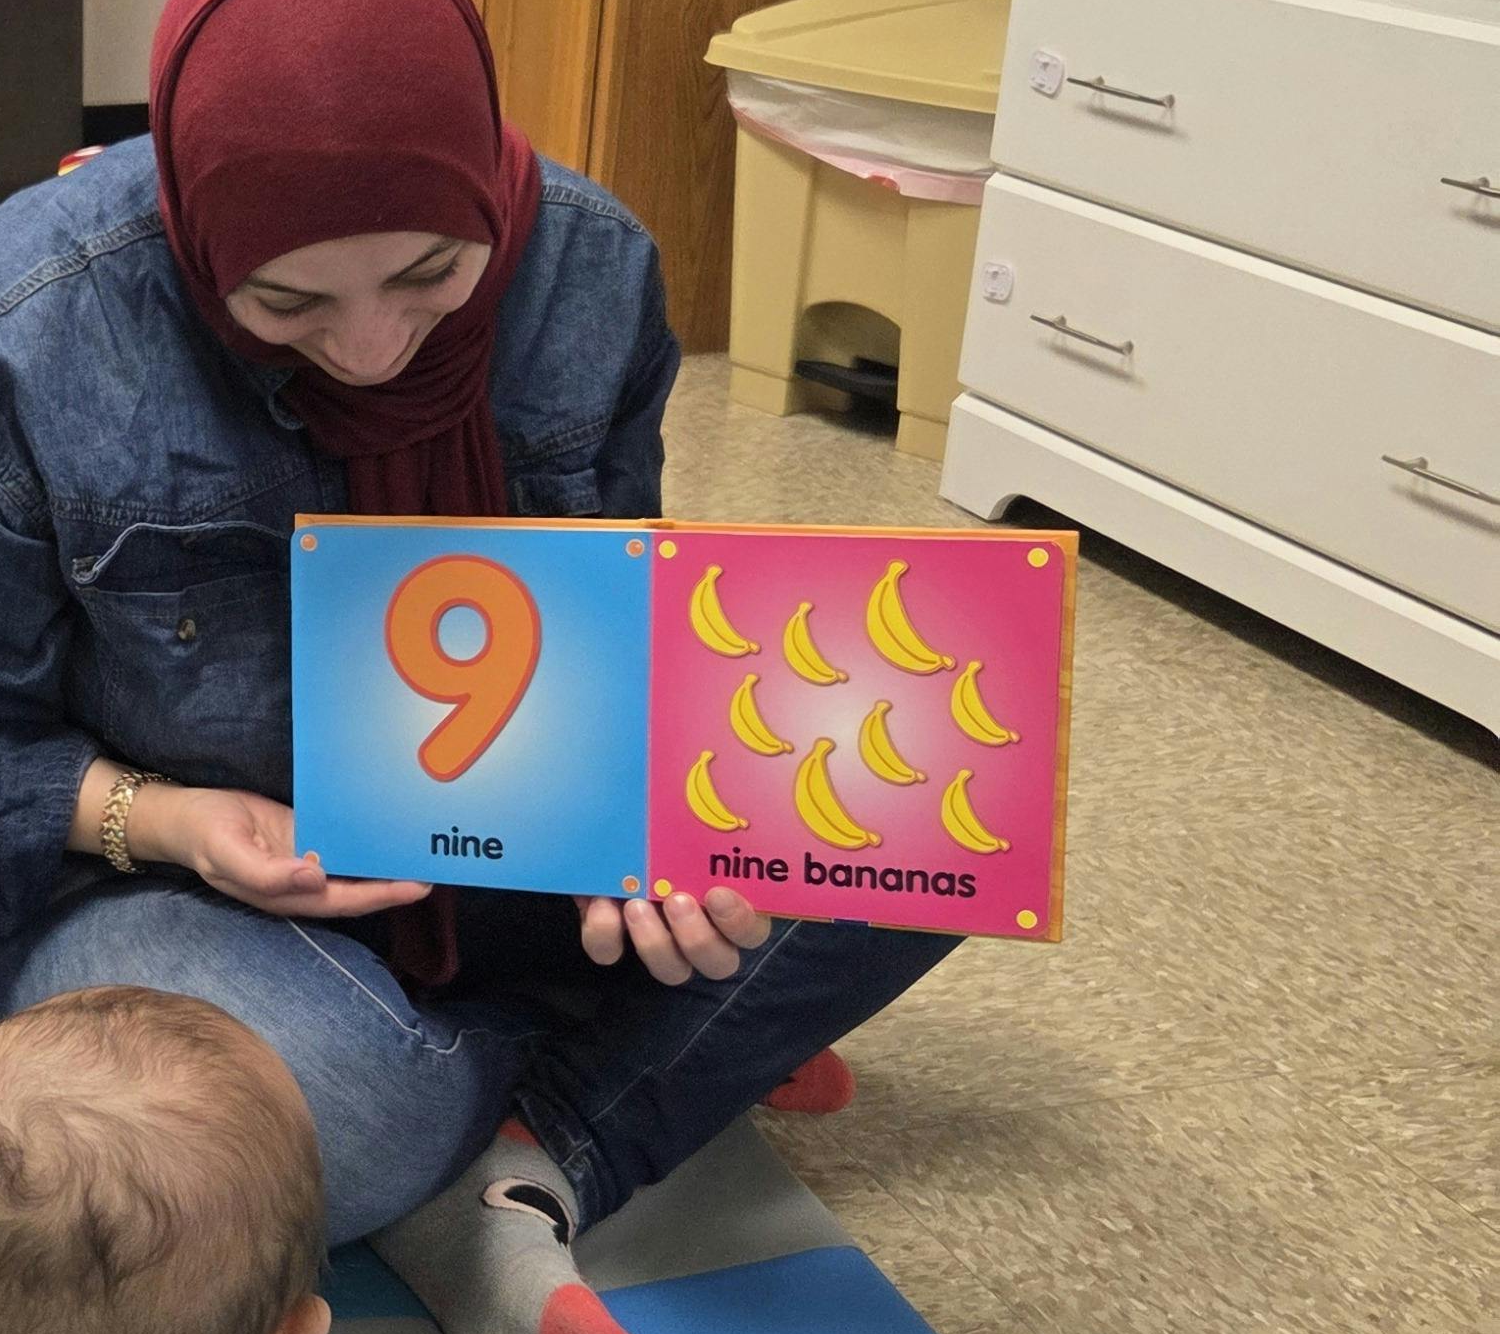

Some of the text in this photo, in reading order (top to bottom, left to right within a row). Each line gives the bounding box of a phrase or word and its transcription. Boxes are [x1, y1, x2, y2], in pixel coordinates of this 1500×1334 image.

[384, 553, 542, 783] 9
[430, 825, 504, 860] nine
[709, 846, 977, 899] nine bananas
